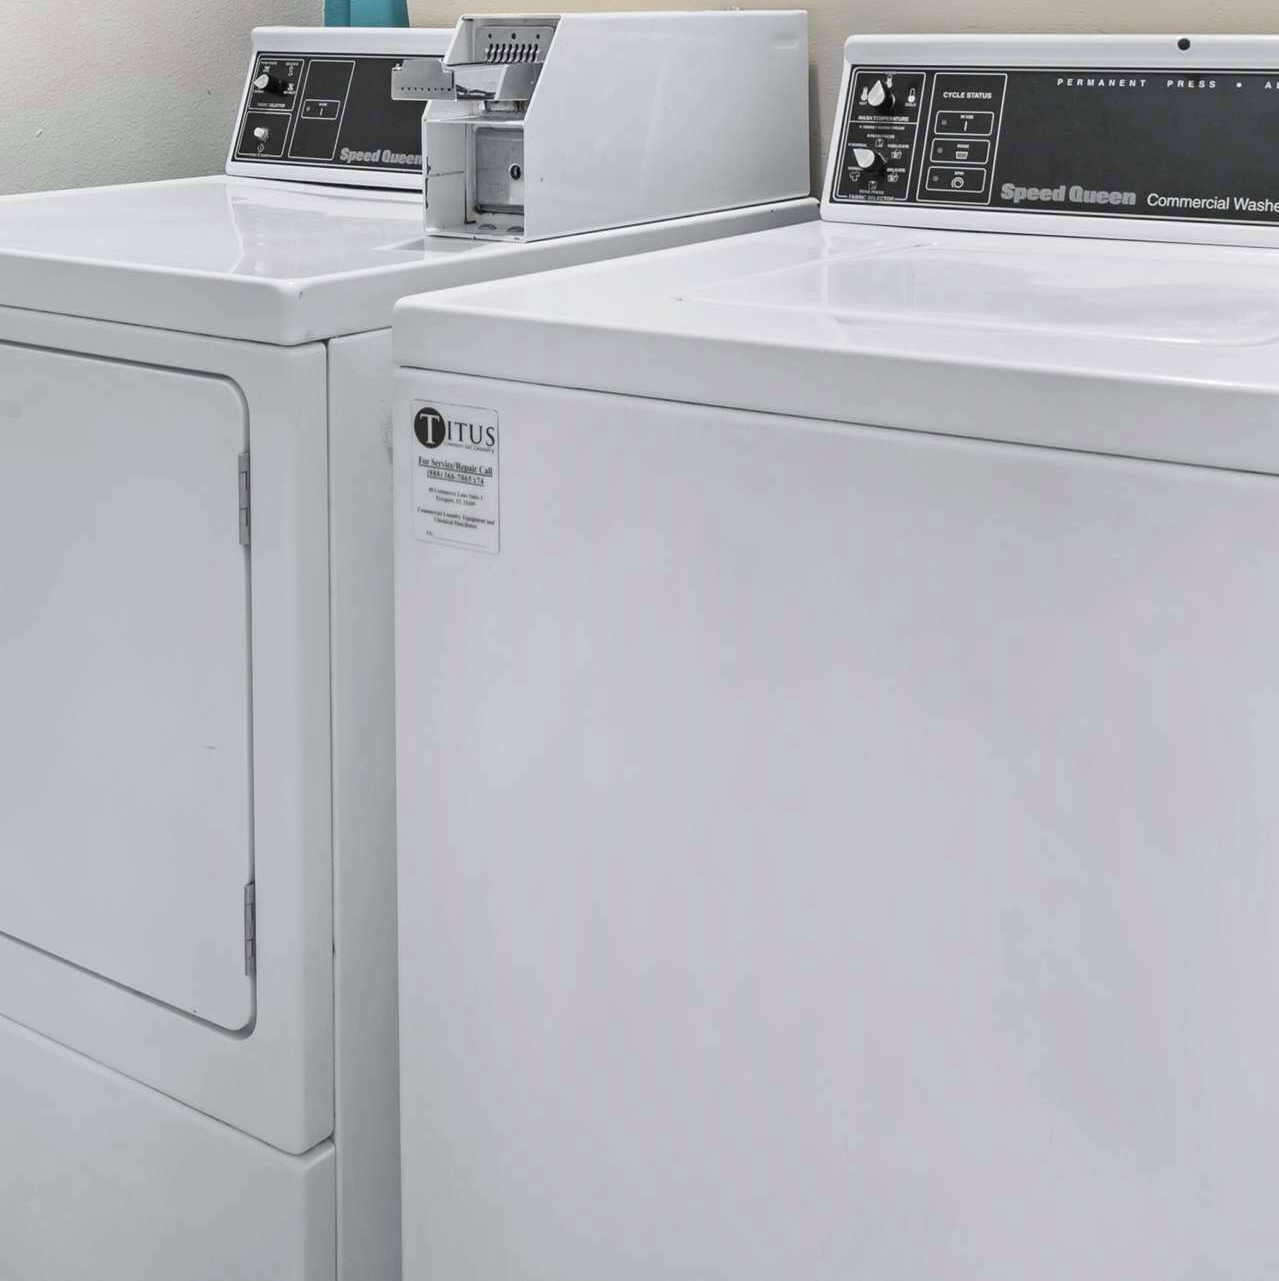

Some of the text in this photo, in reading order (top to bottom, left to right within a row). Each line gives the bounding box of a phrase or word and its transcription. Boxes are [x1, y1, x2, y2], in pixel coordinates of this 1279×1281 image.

[1056, 78, 1147, 88] PERMANENT
[1167, 79, 1217, 89] PRESS
[942, 91, 993, 100] CYCLE STATUS
[340, 147, 381, 164] Speed
[1000, 183, 1066, 204] Speed
[1068, 185, 1137, 206] Queen
[1146, 192, 1230, 210] Commercial
[418, 412, 496, 448] TITUS
